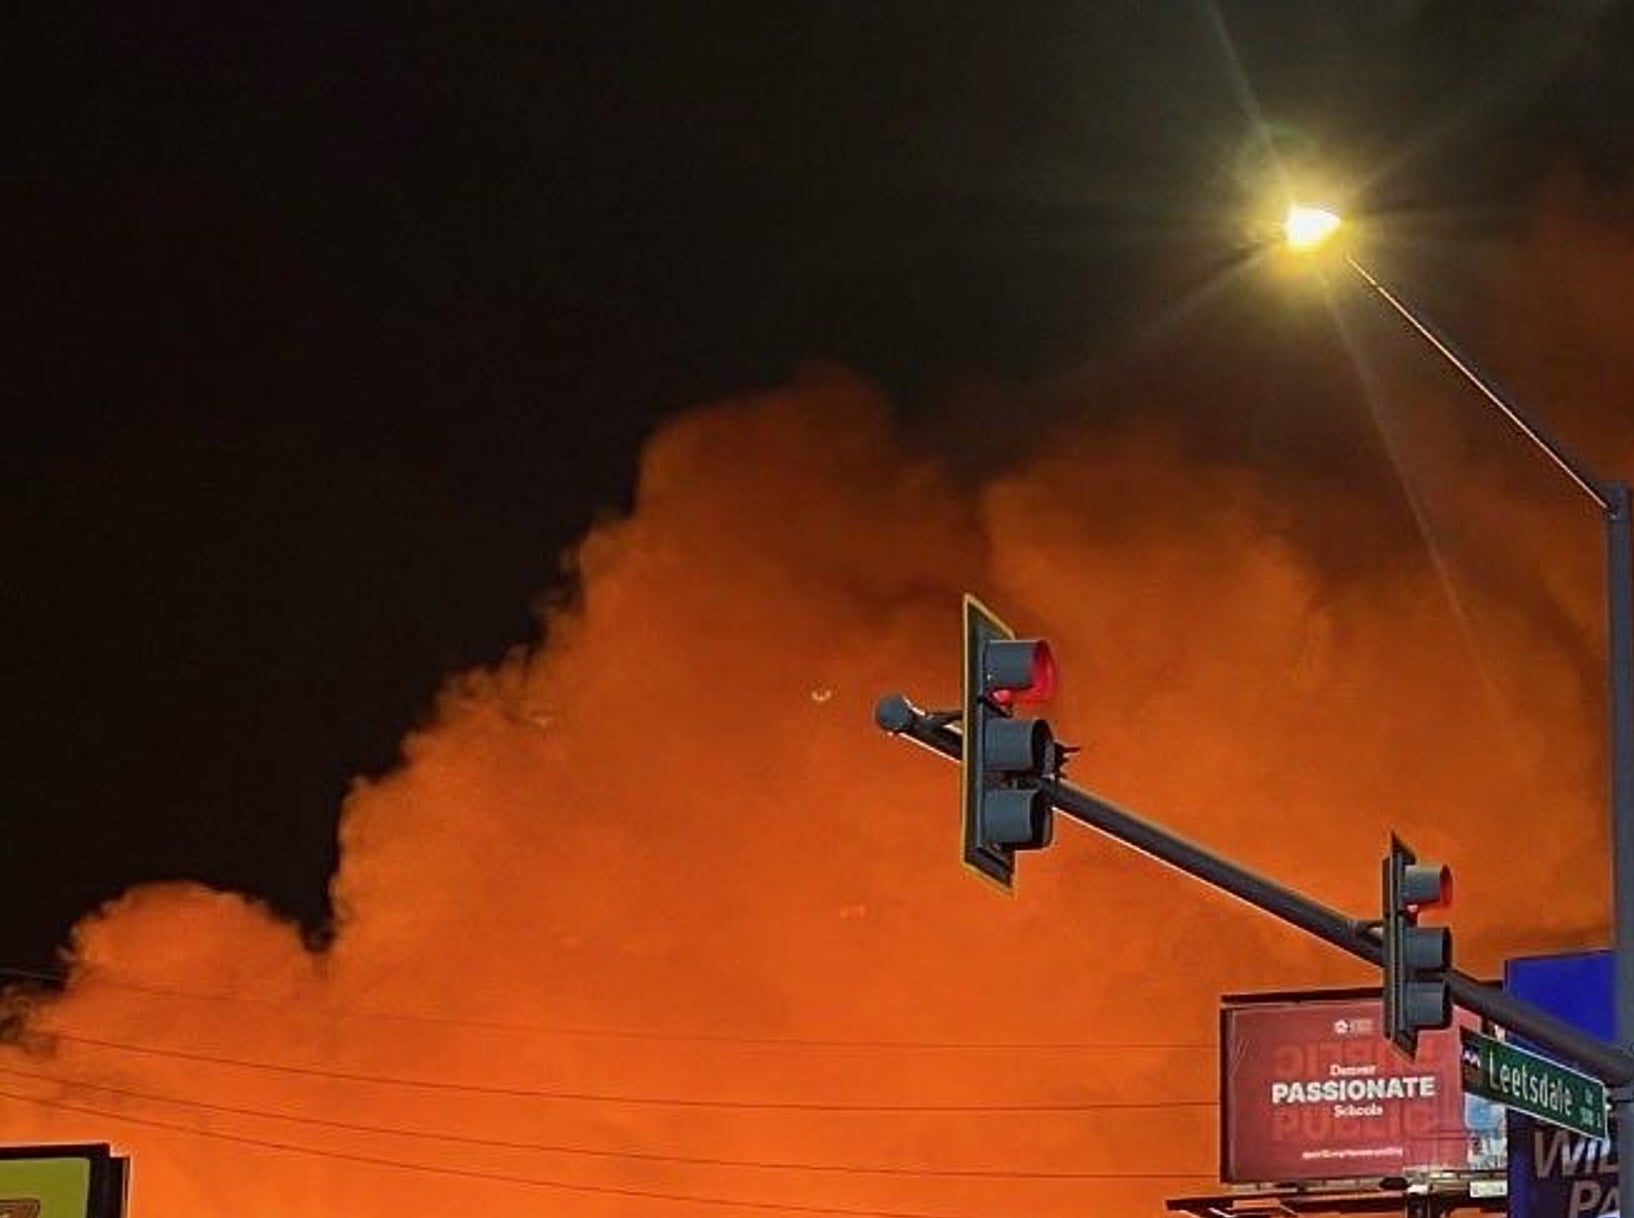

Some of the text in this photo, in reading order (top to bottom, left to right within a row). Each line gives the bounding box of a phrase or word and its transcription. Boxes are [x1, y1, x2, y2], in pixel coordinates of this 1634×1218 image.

[1271, 1077, 1436, 1103] PASSIONATE
[1488, 1048, 1573, 1117] Leetsdale
[1333, 1103, 1384, 1118] Schools
